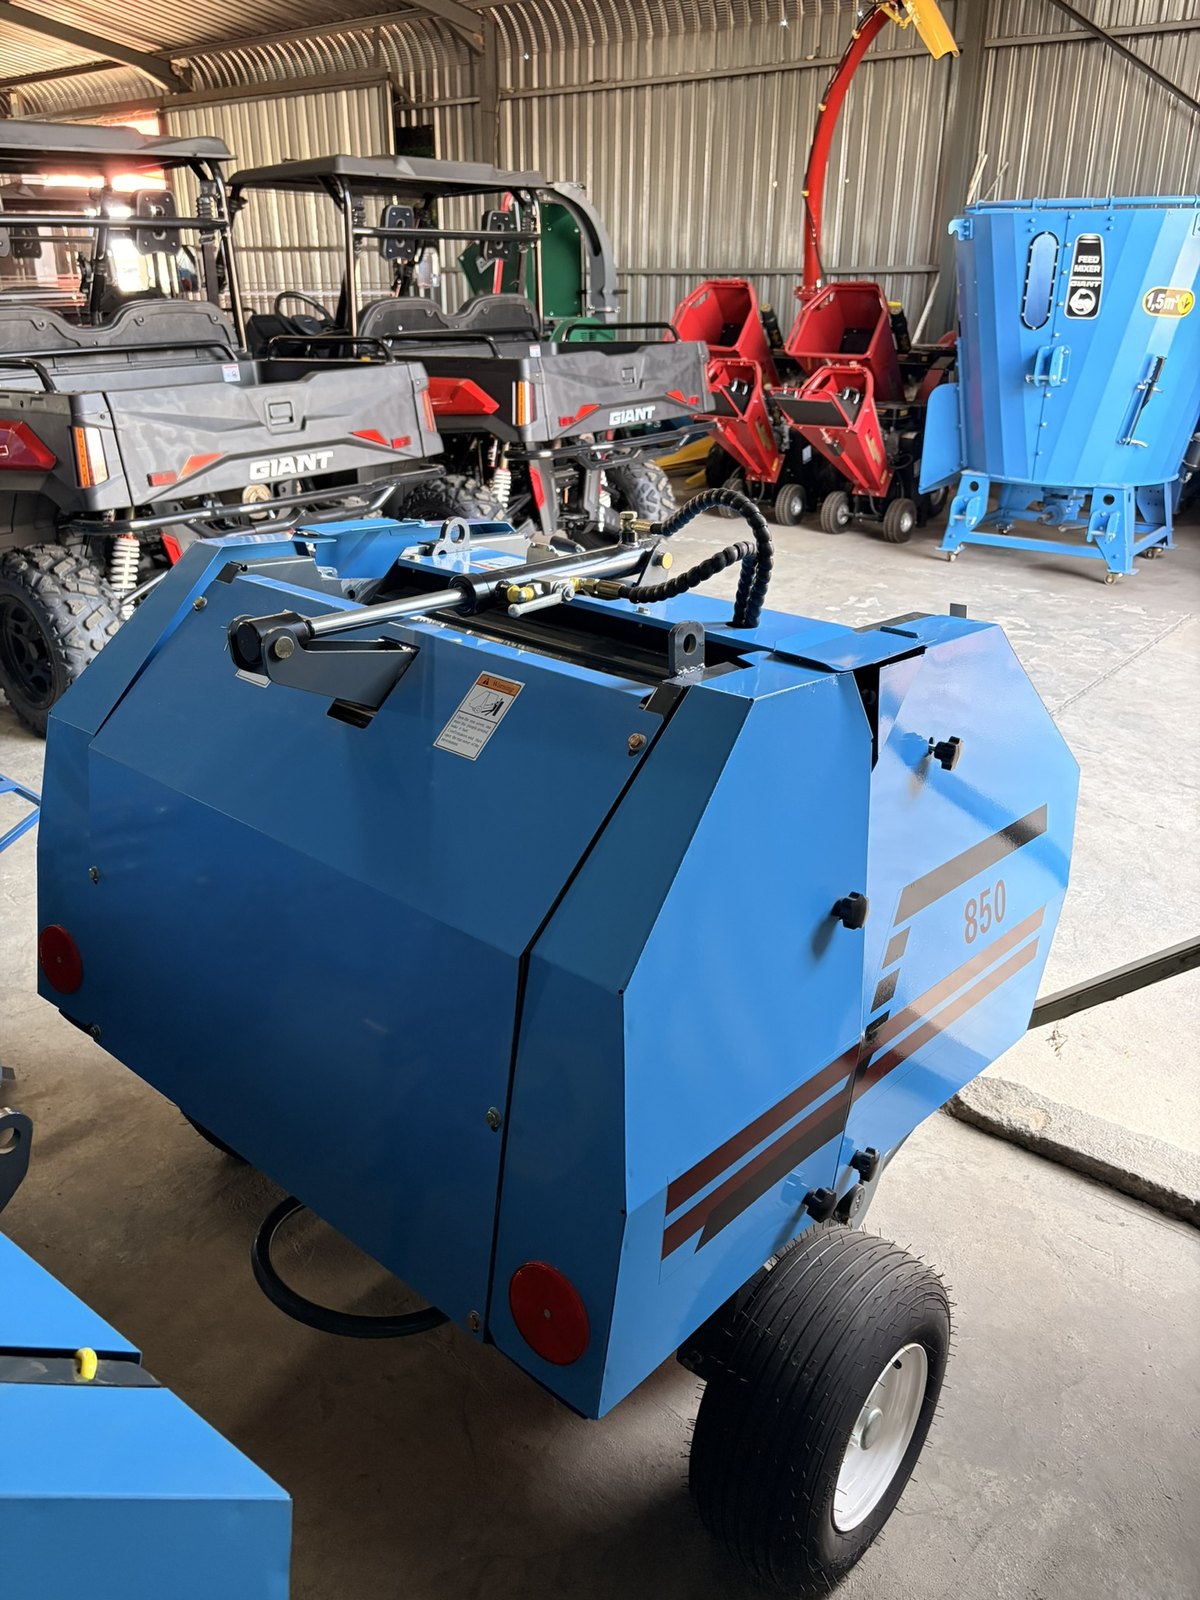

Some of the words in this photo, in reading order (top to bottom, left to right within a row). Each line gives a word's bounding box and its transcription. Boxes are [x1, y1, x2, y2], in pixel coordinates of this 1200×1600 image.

[1073, 264, 1101, 273] MIXER
[1077, 255, 1100, 264] FEED
[608, 404, 656, 426] GIANT
[249, 450, 334, 481] GIANT
[964, 879, 1006, 945] 850
